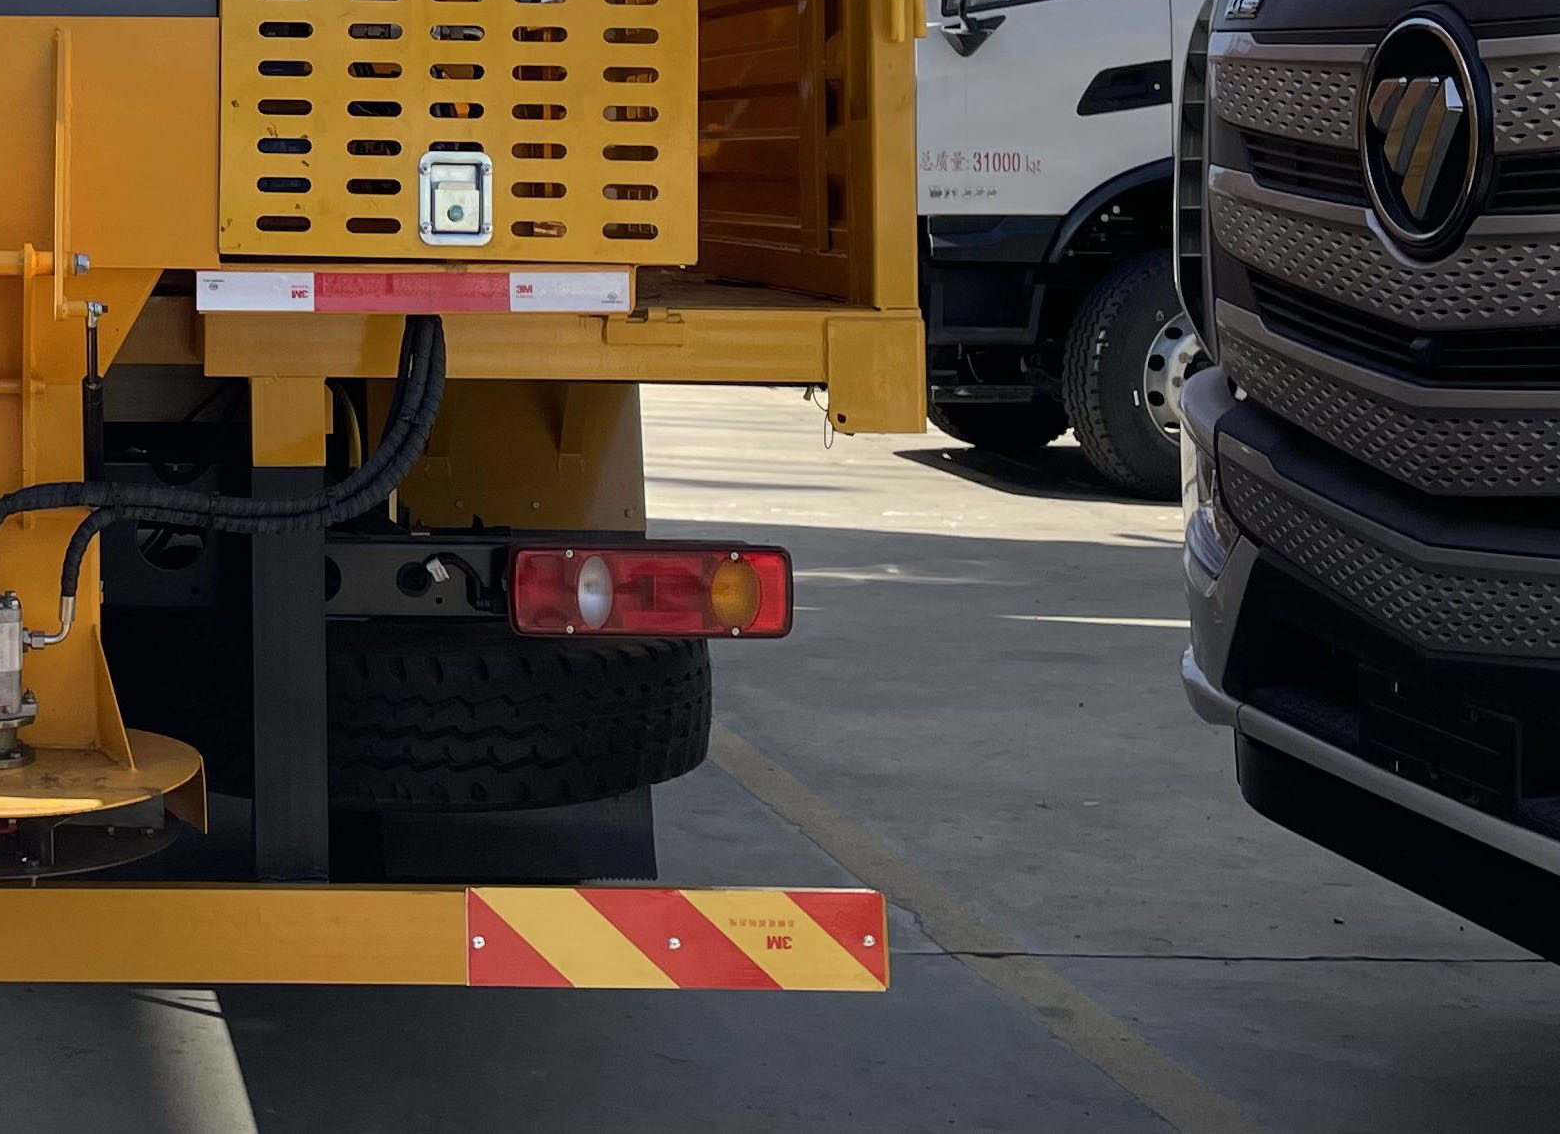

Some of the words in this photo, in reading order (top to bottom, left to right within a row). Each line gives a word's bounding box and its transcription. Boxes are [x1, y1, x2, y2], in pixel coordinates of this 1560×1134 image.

[973, 151, 1021, 173] 31000
[516, 285, 533, 294] 3M
[767, 935, 793, 950] 3M
